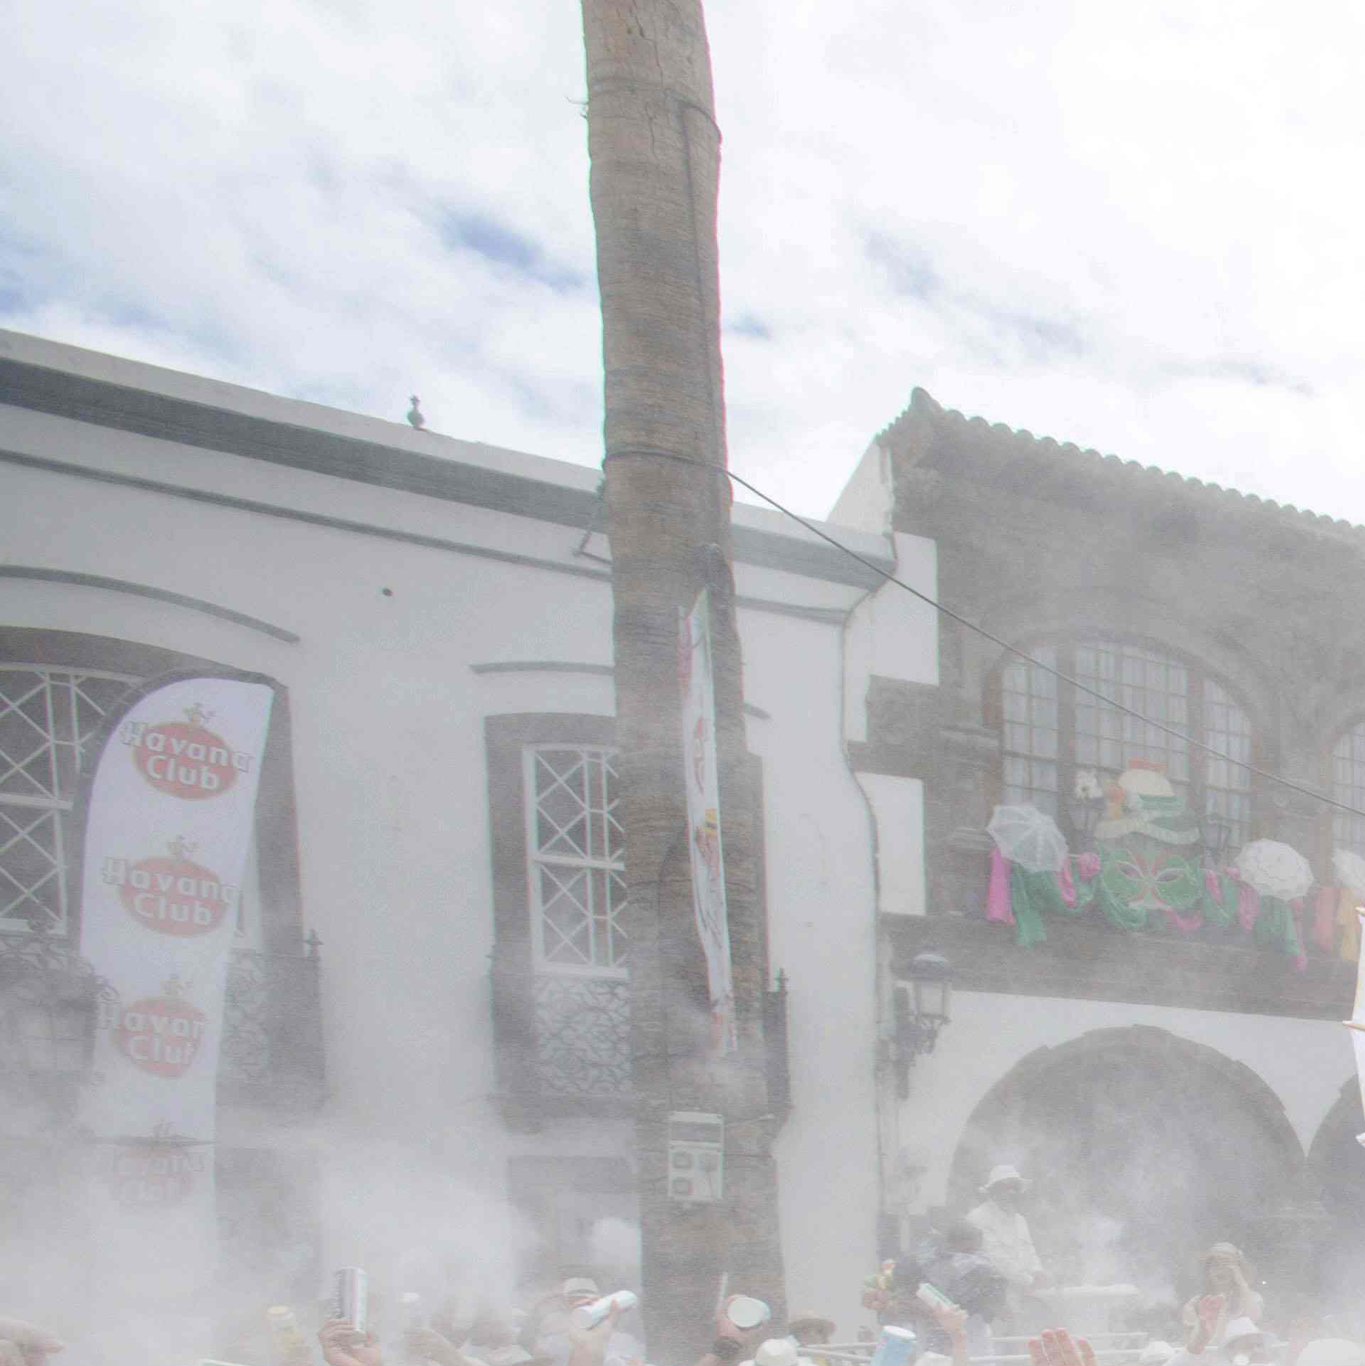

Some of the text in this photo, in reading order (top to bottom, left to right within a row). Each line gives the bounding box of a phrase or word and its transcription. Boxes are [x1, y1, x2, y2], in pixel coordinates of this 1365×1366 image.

[120, 720, 255, 773] Havana
[146, 754, 219, 790] Club
[134, 892, 212, 926] Club
